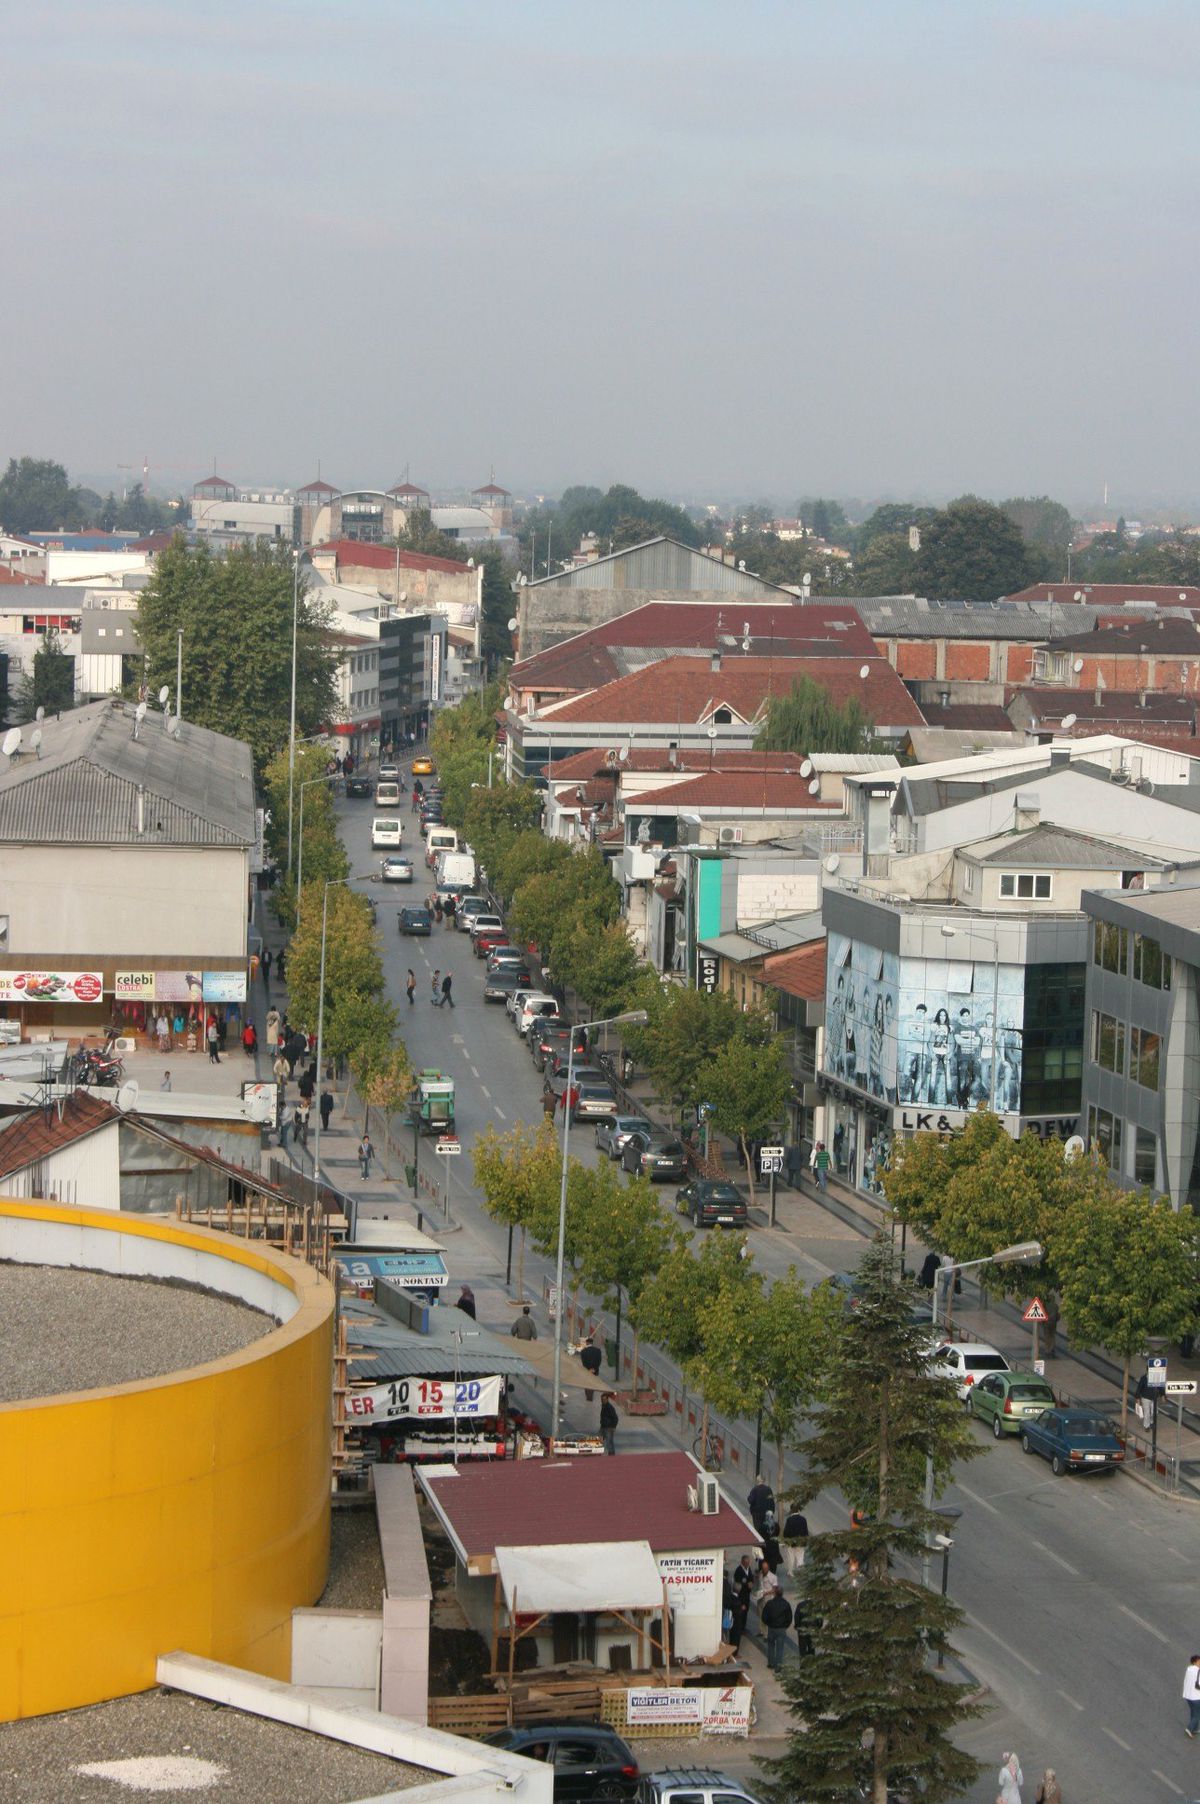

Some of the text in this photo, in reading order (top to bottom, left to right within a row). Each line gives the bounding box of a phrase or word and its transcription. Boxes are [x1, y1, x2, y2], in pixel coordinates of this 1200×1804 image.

[387, 1381, 410, 1405] 10
[418, 1381, 443, 1404] 15
[455, 1381, 481, 1403] 20
[660, 1575, 713, 1587] TAŞINDIK
[669, 1697, 697, 1705] BETON
